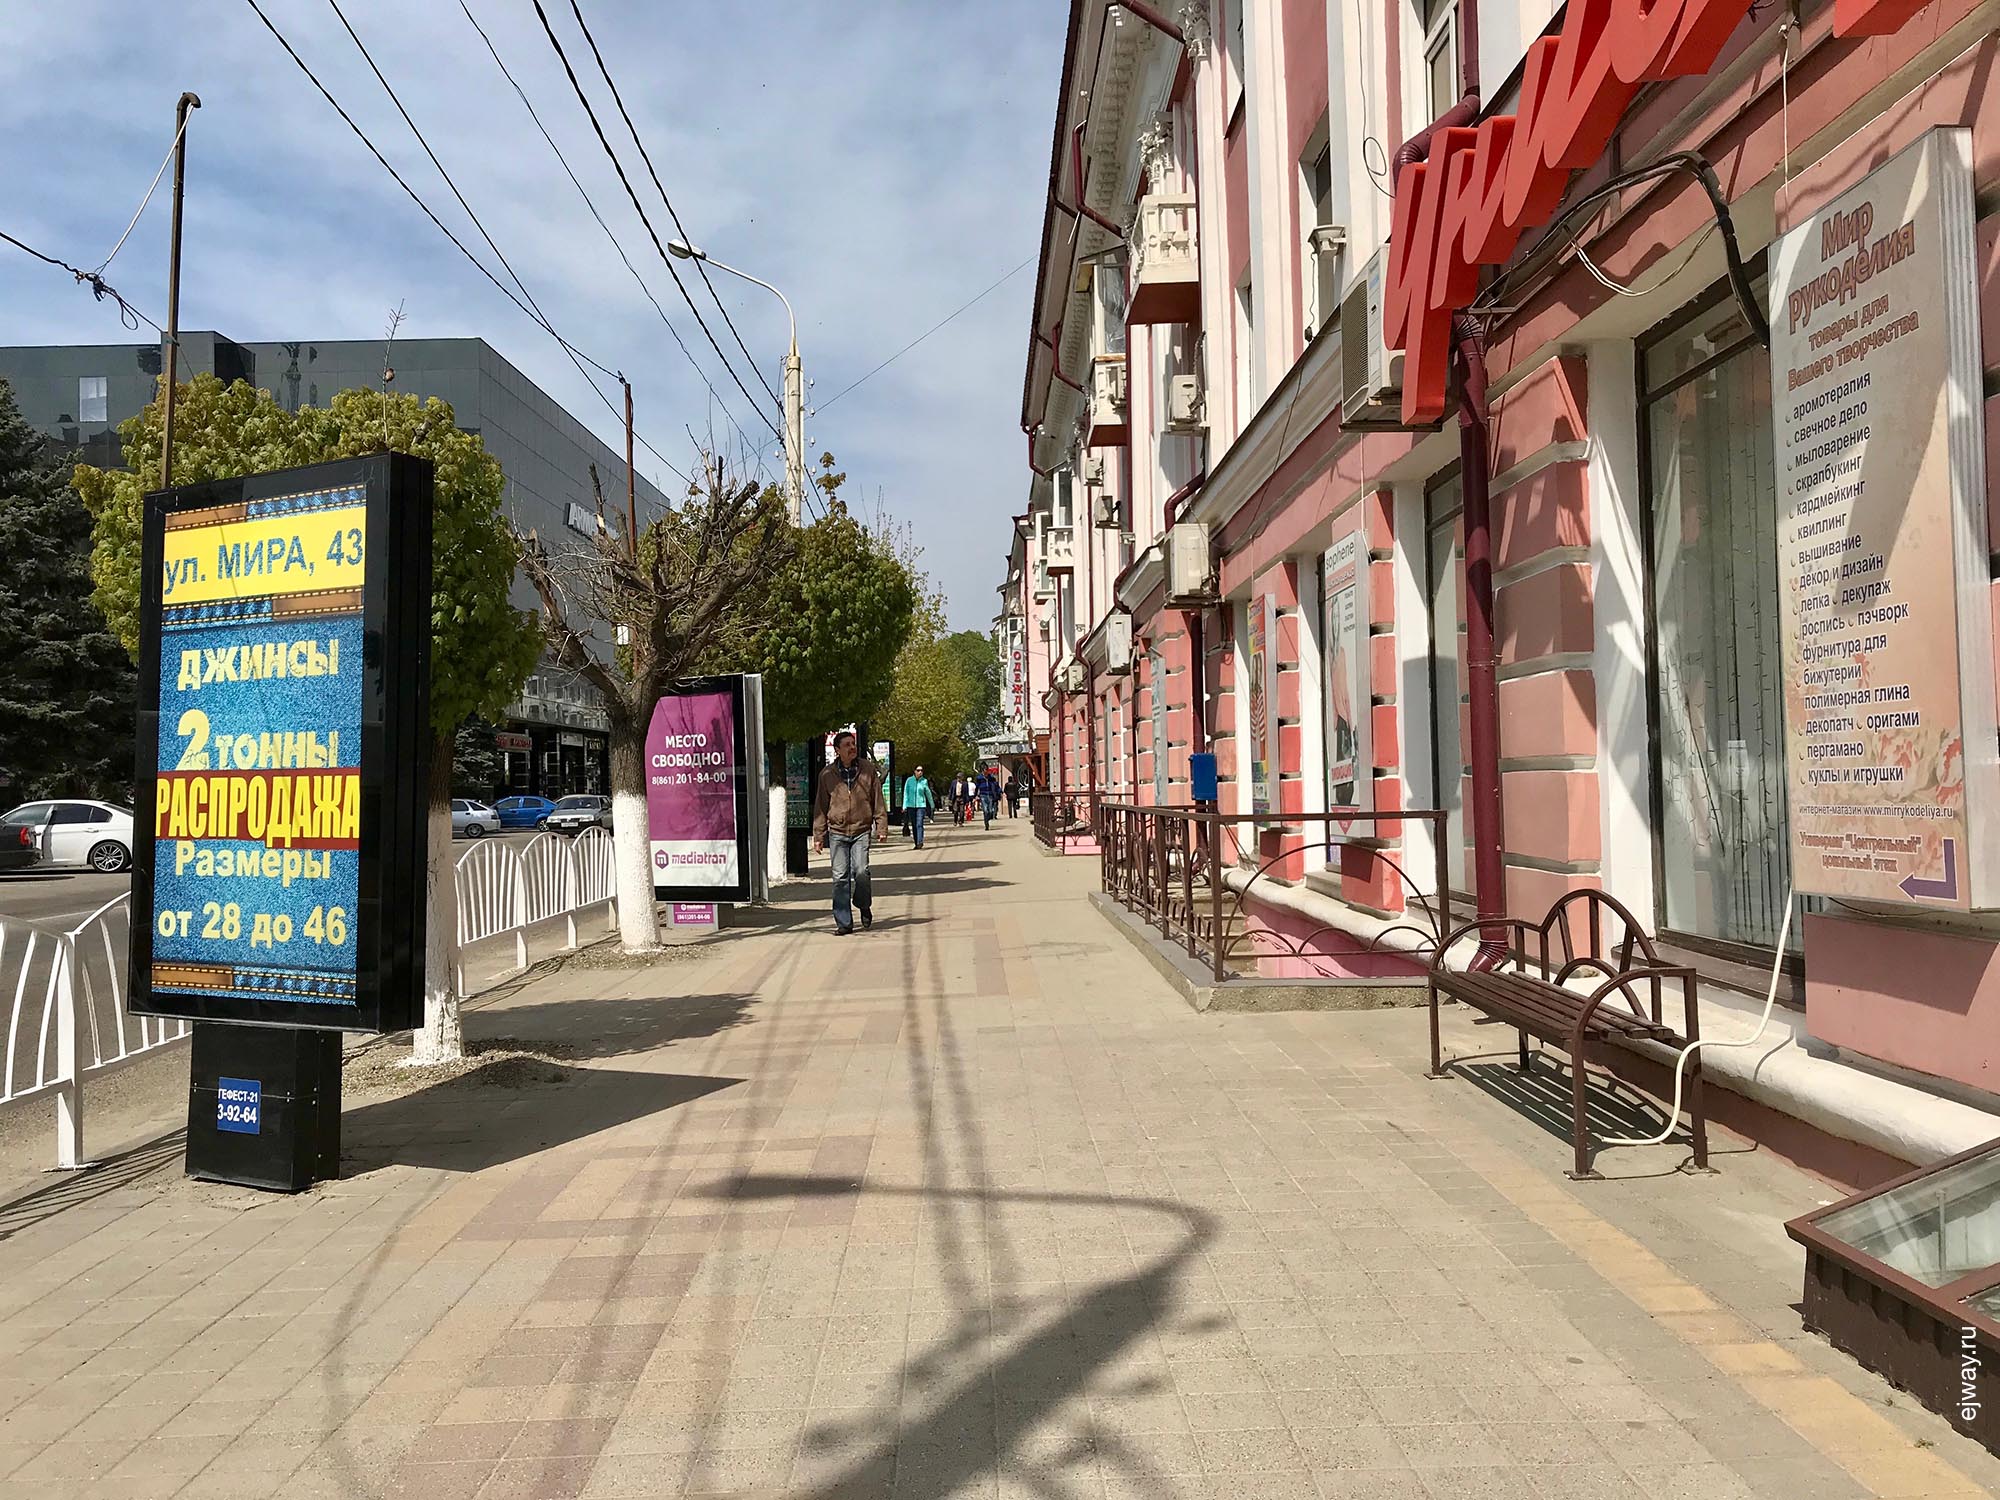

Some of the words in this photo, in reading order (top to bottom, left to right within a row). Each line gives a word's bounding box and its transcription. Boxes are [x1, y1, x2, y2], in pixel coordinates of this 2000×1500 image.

[1821, 201, 1873, 262] Мир
[1788, 220, 1915, 335] рукоделия
[1808, 310, 1858, 351] товары
[1861, 294, 1889, 328] для
[1788, 353, 1833, 391] Вашего
[1836, 310, 1920, 367] творчества
[1793, 372, 1871, 421] аромотерапия
[1794, 416, 1836, 444] свечное
[1838, 400, 1868, 428] дело
[1796, 424, 1871, 468] мыловарение
[1796, 455, 1862, 493] скрапбукинг
[1797, 480, 1865, 517] кардмейкинг
[1798, 512, 1847, 540] квиллинг
[163, 558, 206, 596] ул.
[218, 535, 314, 580] МИРА,
[326, 528, 363, 567] 43
[1326, 542, 1354, 570] sophene
[1798, 534, 1862, 564] вышивание
[1800, 569, 1830, 590] декор
[1832, 568, 1839, 580] и
[1842, 555, 1884, 580] дизайн
[1800, 594, 1830, 612] лепка
[1842, 580, 1891, 606] декупаж
[1802, 617, 1845, 641] роспись
[1858, 603, 1909, 626] пэчворк
[1802, 637, 1861, 665] фурнитура
[1864, 634, 1887, 653] для
[1012, 651, 1023, 716] ОДЕЖДА
[1804, 664, 1862, 686] бижутерии
[1804, 689, 1870, 710] полимерная
[1874, 685, 1910, 702] глина
[176, 708, 210, 771] 2
[665, 734, 706, 748] МЕСТО
[1806, 718, 1854, 736] декопатч
[1866, 712, 1920, 732] оригами
[652, 752, 726, 769] СВОБОДНО!
[1807, 742, 1864, 761] пергамано
[652, 776, 674, 786] 8(861)
[676, 772, 727, 785] 201-84-00
[1808, 768, 1840, 786] куклы
[1844, 770, 1850, 782] и
[1854, 767, 1904, 785] игрушки
[156, 774, 360, 848] РАСПРОДАЖА
[1800, 805, 1862, 816] интернет-магазин
[1864, 804, 1953, 819] www.mirrykodeliya.ru
[176, 840, 332, 888] Размеры
[158, 910, 192, 937] от
[202, 901, 241, 940] 28
[251, 914, 292, 948] до
[304, 906, 346, 945] 46
[218, 1088, 258, 1103] ГЕФЕСТ-21
[217, 1104, 257, 1124] 3-92-64
